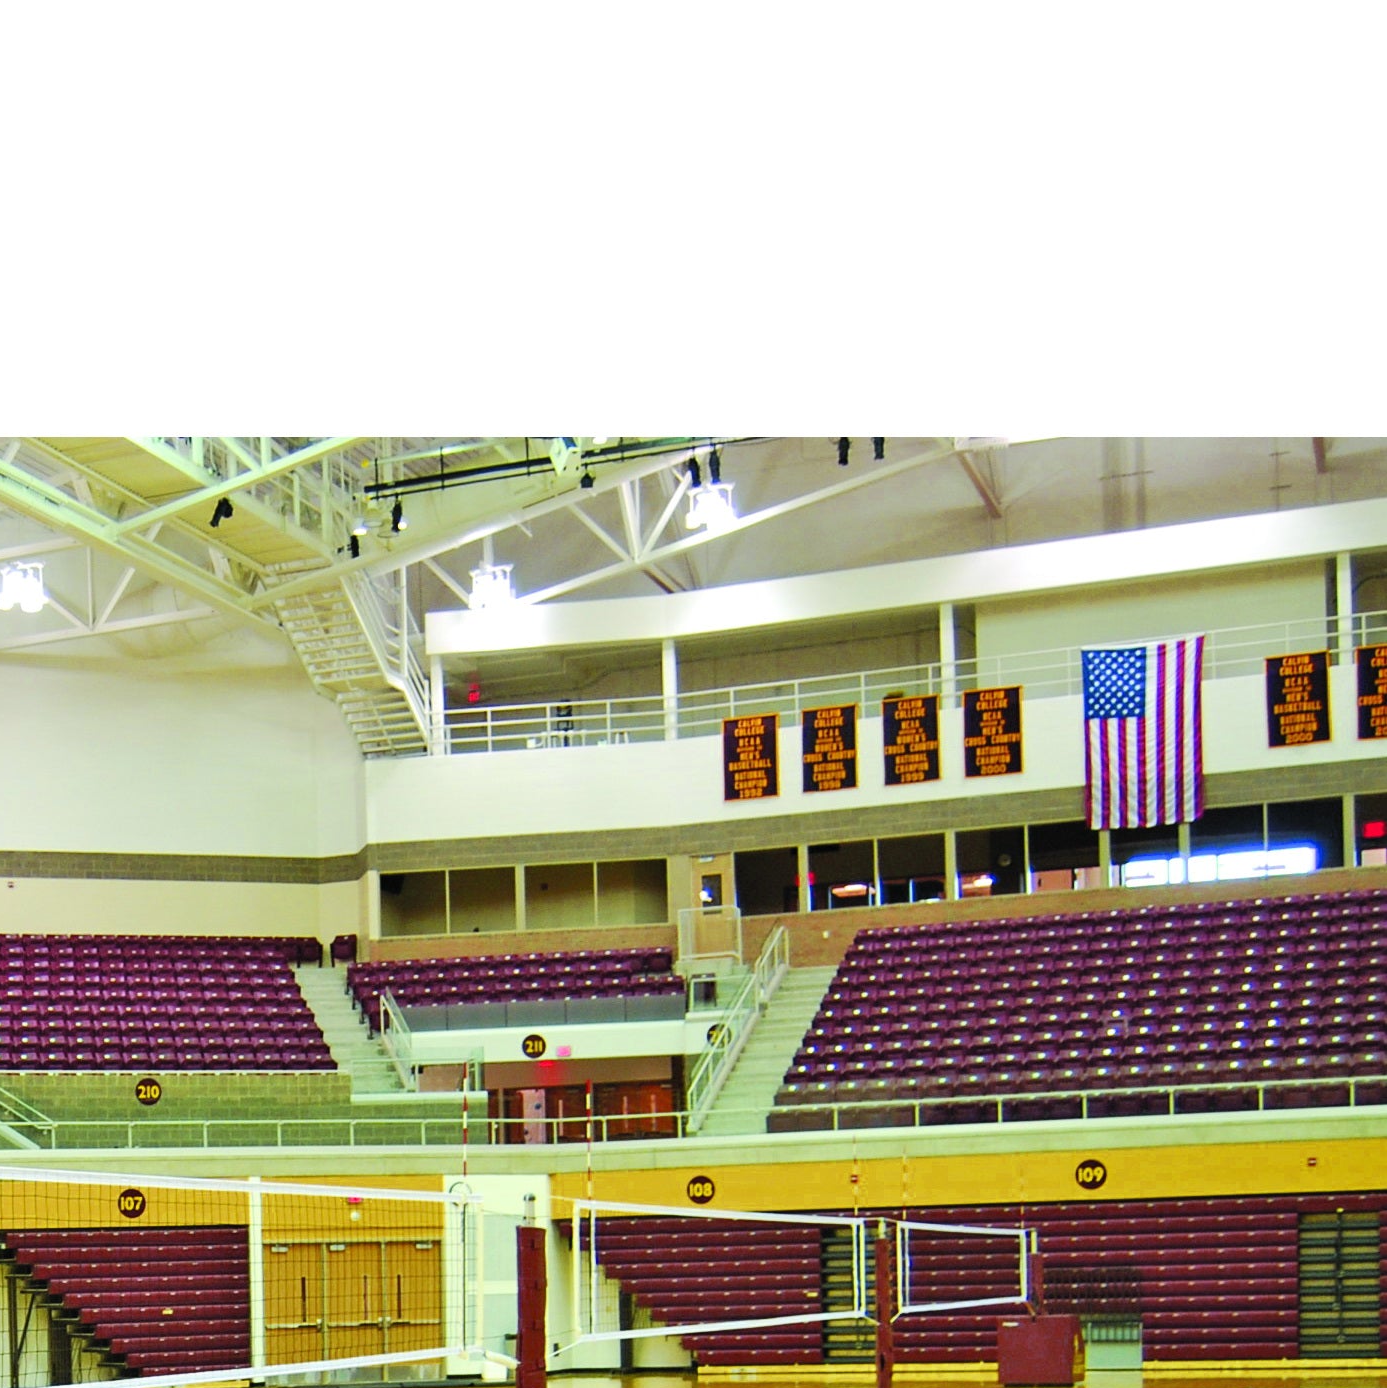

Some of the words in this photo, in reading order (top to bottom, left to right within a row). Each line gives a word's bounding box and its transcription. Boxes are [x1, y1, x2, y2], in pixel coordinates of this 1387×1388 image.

[1282, 655, 1310, 666] CALVIN
[1279, 663, 1314, 676] COLLEGE
[1285, 676, 1308, 687] NCAA
[980, 690, 1005, 701] CALVIN
[898, 699, 923, 710] CALVIN
[976, 698, 1008, 711] COLLEGE
[817, 708, 841, 719] CALVIN
[894, 707, 926, 720] COLLEGE
[982, 711, 1002, 721] NCAA
[738, 718, 762, 728] CALVIN
[901, 720, 920, 730] NCAA
[818, 728, 839, 738] NCAA
[739, 736, 760, 747] NCAA
[980, 763, 1007, 775] 2000
[524, 1039, 543, 1054] 211
[137, 1084, 161, 1100] 210
[1078, 1166, 1105, 1184] 109
[689, 1182, 714, 1198] 108
[120, 1196, 144, 1211] 107
